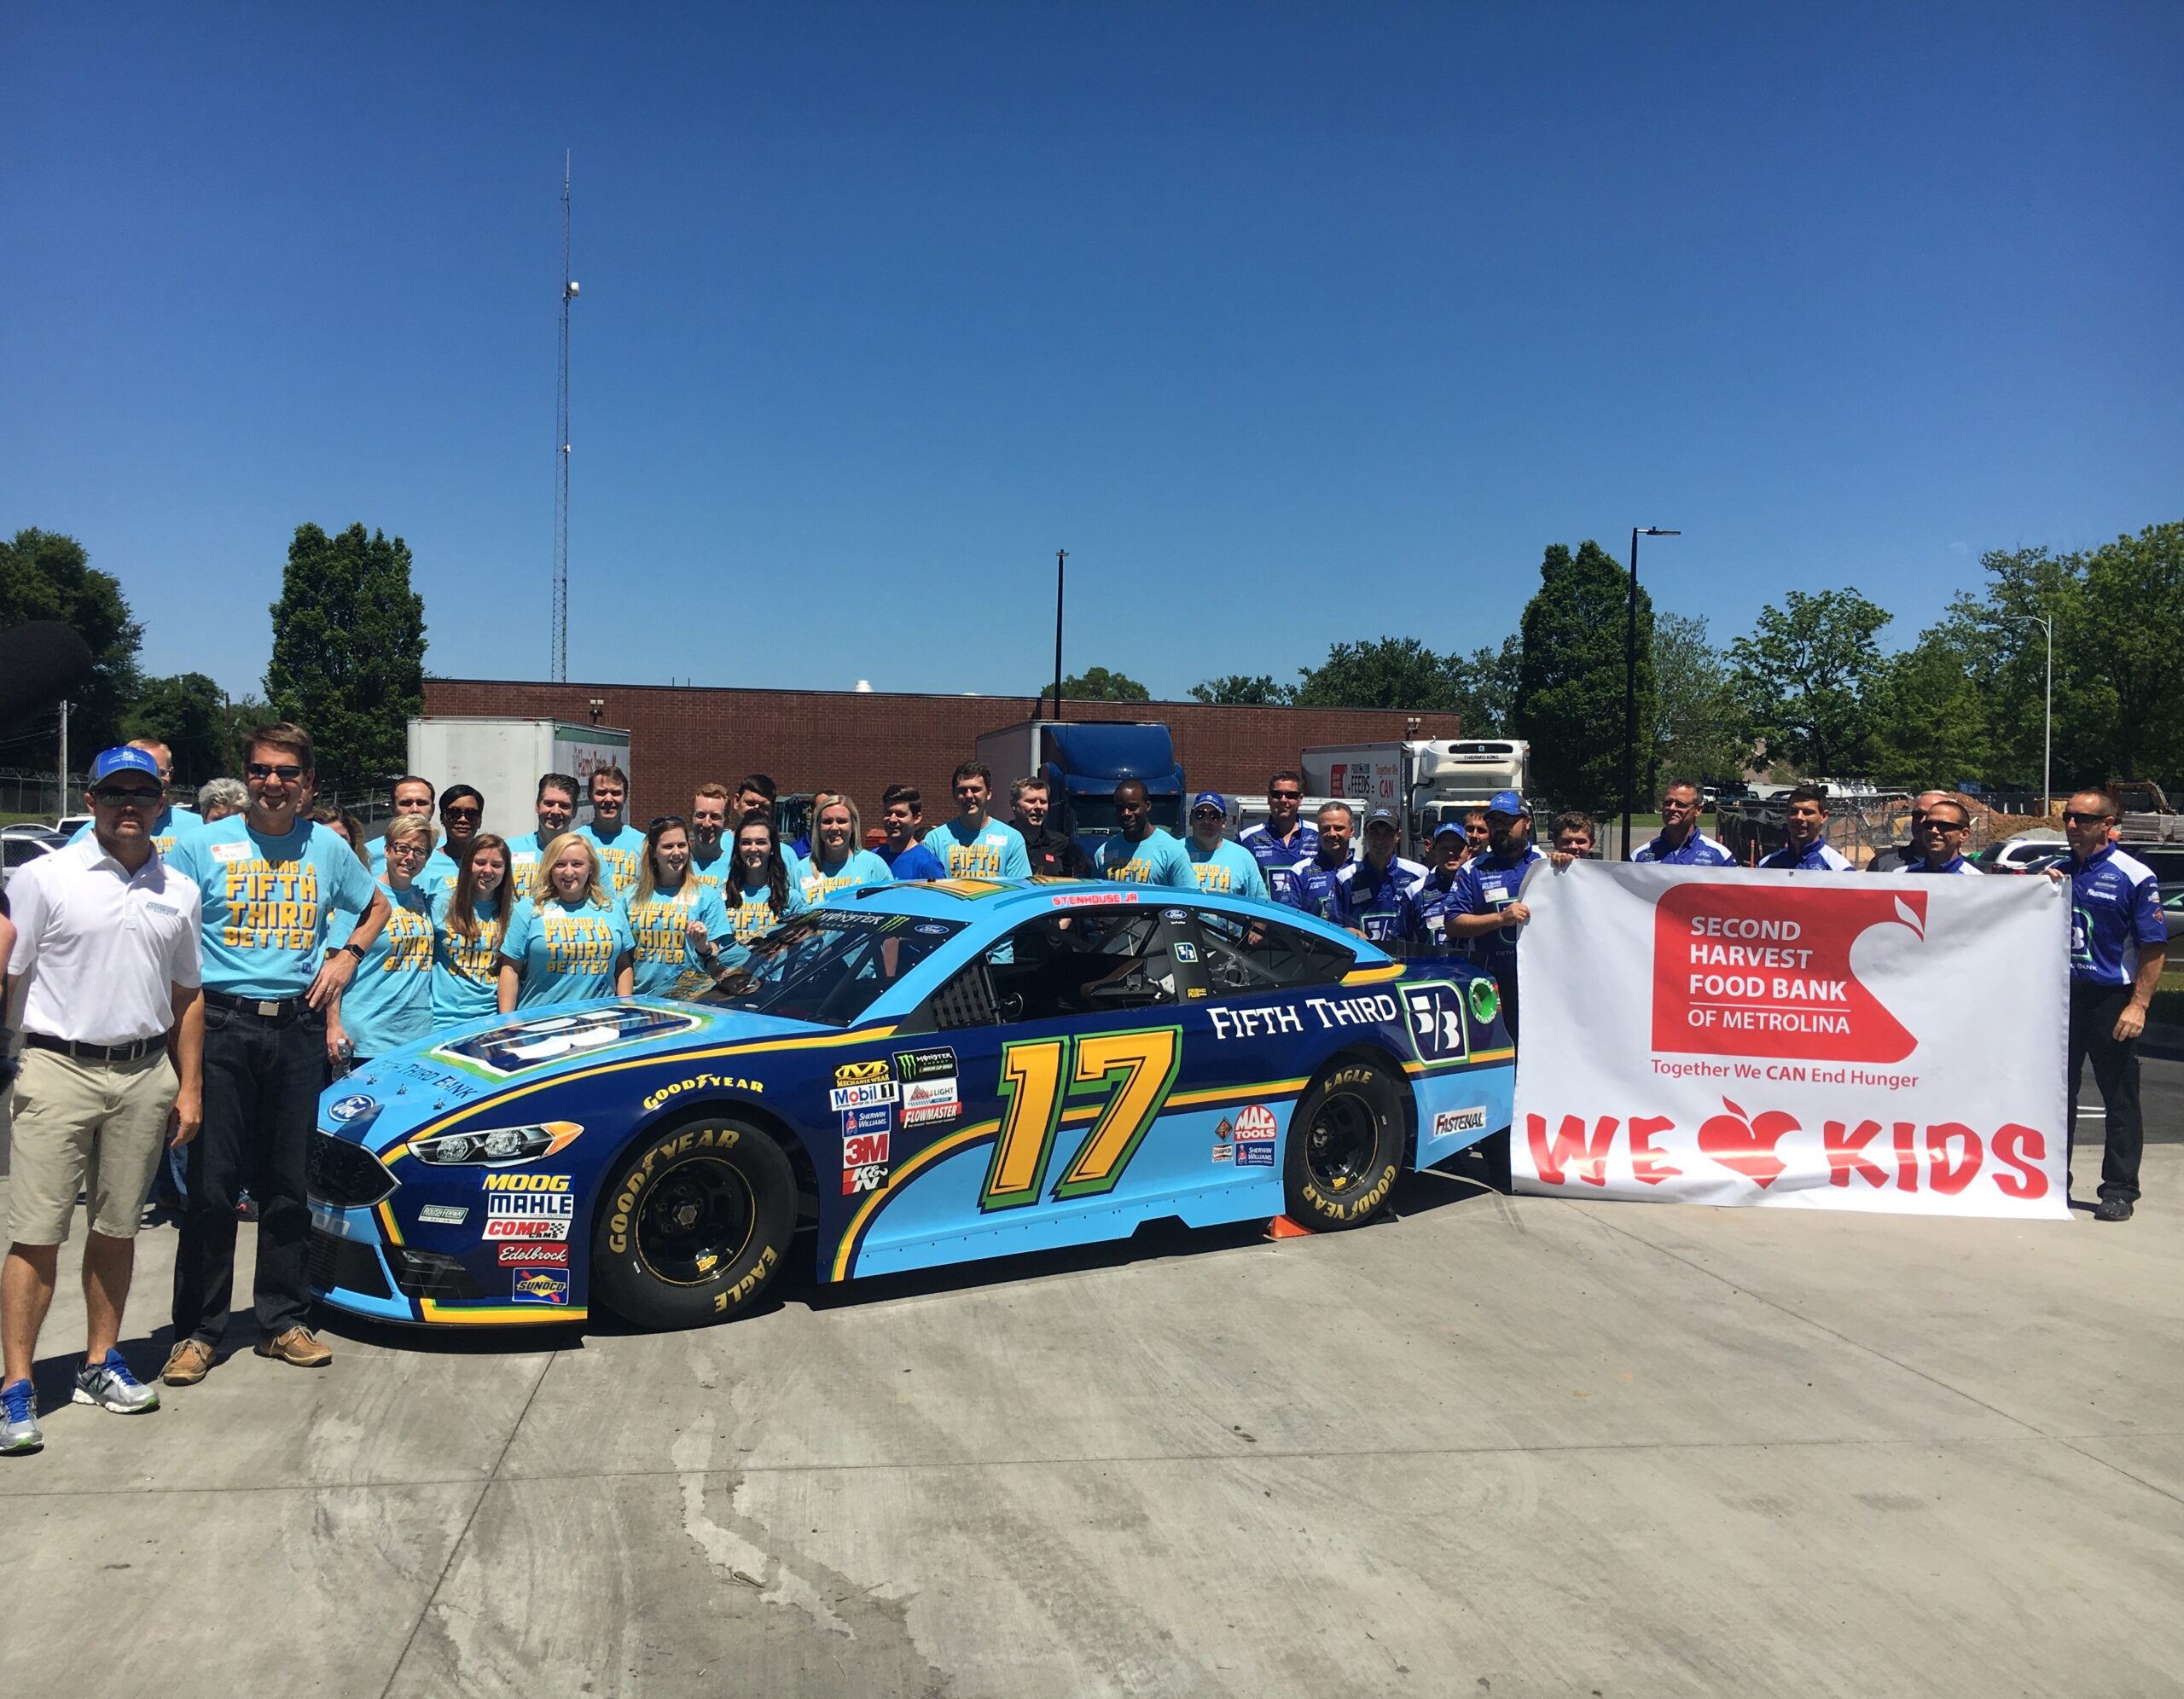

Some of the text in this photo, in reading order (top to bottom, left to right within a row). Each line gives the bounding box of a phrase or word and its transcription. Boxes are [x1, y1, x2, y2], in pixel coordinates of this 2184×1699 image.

[1351, 775, 1370, 793] FEEDS
[1380, 780, 1394, 798] CAN
[993, 845, 999, 854] A
[227, 861, 317, 876] BANKING A
[950, 854, 1001, 872] FIFTH
[1107, 867, 1151, 884] FIFTH
[226, 875, 317, 902] FIFTH
[2087, 889, 2117, 901] FASTENAL
[1053, 894, 1138, 905] STENHOUSE JR
[227, 902, 317, 931] THIRD
[630, 911, 688, 931] FIFTH
[224, 927, 316, 950] BETTER
[545, 925, 613, 942] FIFTH
[922, 925, 944, 934] Ford
[1691, 916, 1802, 941] SECOND
[547, 941, 613, 961] THIRD
[1690, 944, 1813, 970] HARVEST
[546, 960, 610, 976] BETTER
[2077, 963, 2098, 971] BANK
[1689, 974, 1847, 1002] FOOD BANK
[1205, 994, 1397, 1040] FIFTH THIRD
[1474, 1008, 1497, 1024] ETHANOL
[1687, 1009, 1850, 1034] OF METROLINA
[399, 1064, 439, 1081] THIRD
[433, 1075, 478, 1099] BANK
[837, 1074, 890, 1087] MECHANIX WEAR
[1324, 1069, 1373, 1093] EAGLE
[1652, 1059, 1919, 1090] Together We CAN End Hunger
[643, 1074, 764, 1110] GOODYEAR
[834, 1085, 877, 1105] Mobil
[912, 1087, 954, 1099] Coors LIGHT
[333, 1096, 367, 1118] Ford
[859, 1111, 886, 1121] SHERWIN
[903, 1105, 957, 1128] FLOWMASTER
[858, 1118, 886, 1128] WILLIAMS
[983, 1026, 1181, 1209] 17
[1235, 1106, 1276, 1130] MAC
[1435, 1112, 1484, 1135] FASTENAL
[1235, 1128, 1275, 1139] TOOLS
[845, 1134, 888, 1165] 3M
[1527, 1113, 2048, 1201] WE KIDS
[482, 1174, 572, 1192] MOOG
[851, 1165, 888, 1193] K&N
[609, 1129, 740, 1253] GOODYEAR
[1302, 1165, 1396, 1221] GOODYEAR
[423, 1207, 444, 1217] ROUSH
[490, 1195, 572, 1214] MAHLE
[488, 1221, 550, 1236] COMP
[499, 1246, 567, 1261] Edelbrock
[518, 1282, 565, 1291] SUNOCO
[713, 1245, 778, 1312] EAGLE
